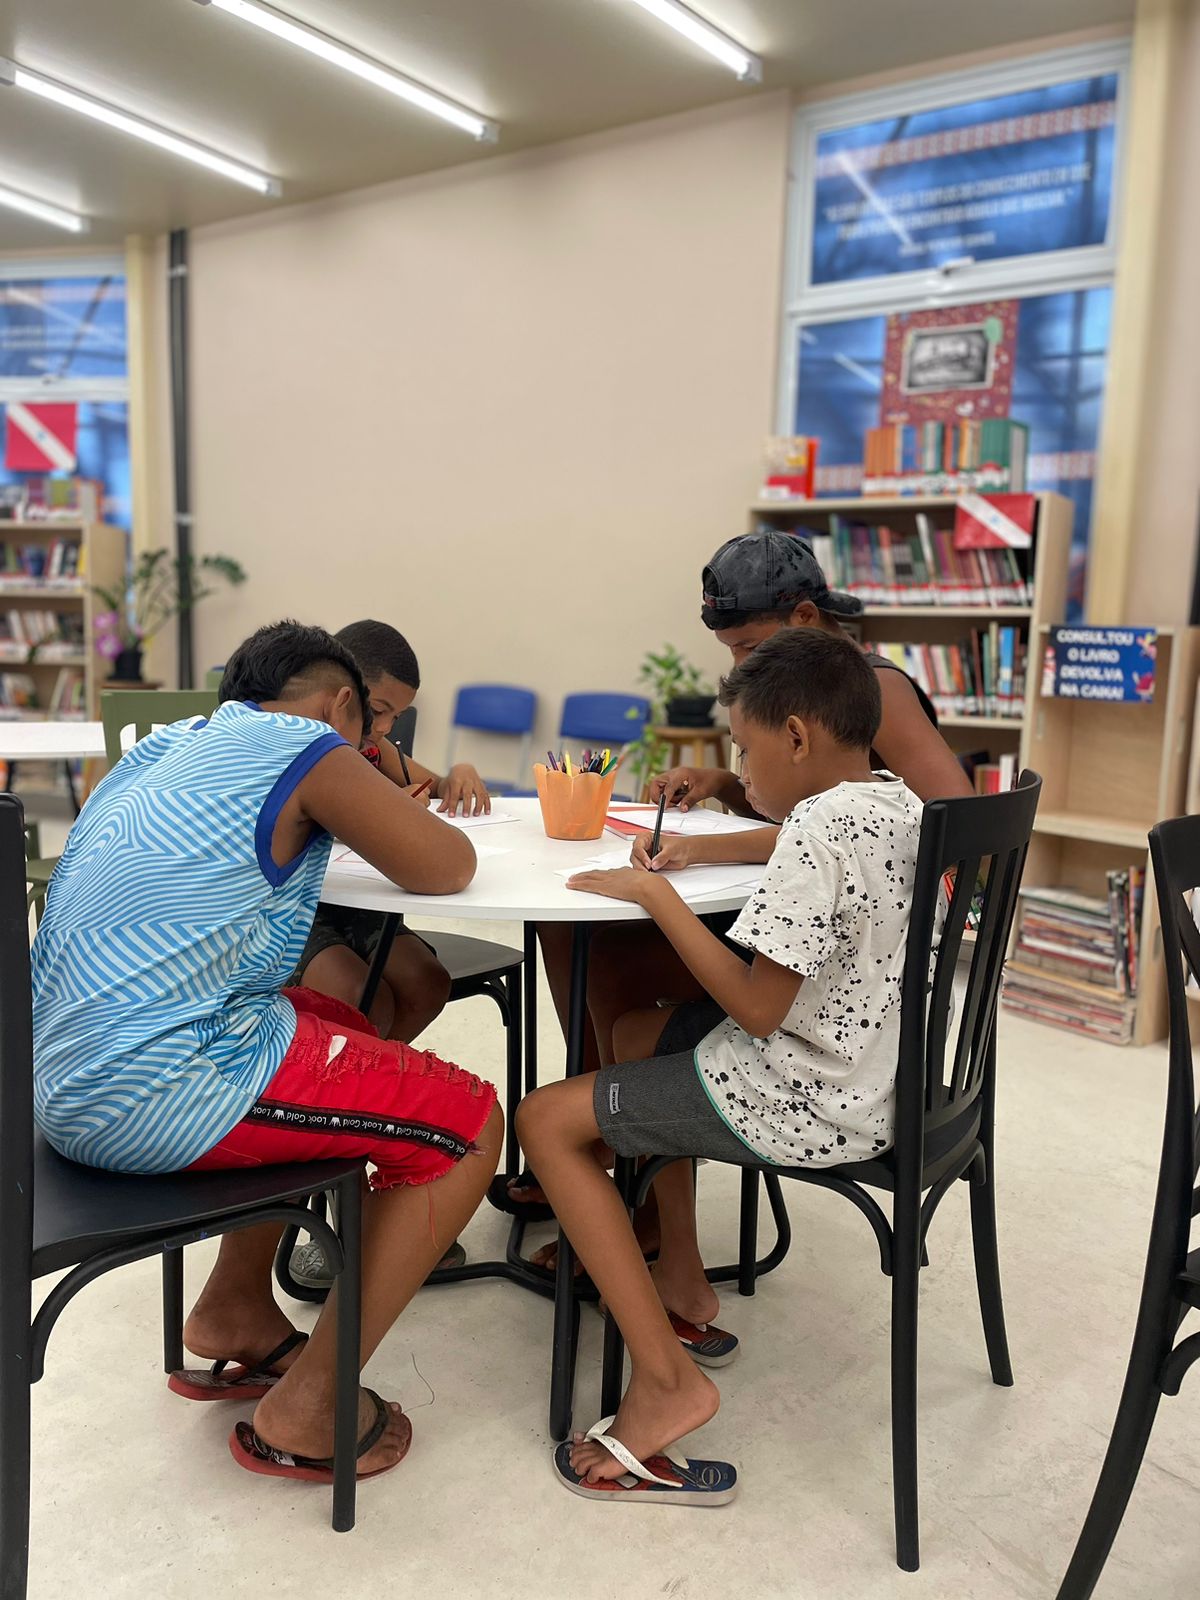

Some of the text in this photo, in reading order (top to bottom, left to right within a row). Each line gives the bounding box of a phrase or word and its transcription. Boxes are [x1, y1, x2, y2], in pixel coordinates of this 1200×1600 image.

[1057, 629, 1134, 645] CONSULTOU
[252, 1106, 271, 1116] Look
[286, 1112, 306, 1123] Gold
[362, 1120, 383, 1131] Look
